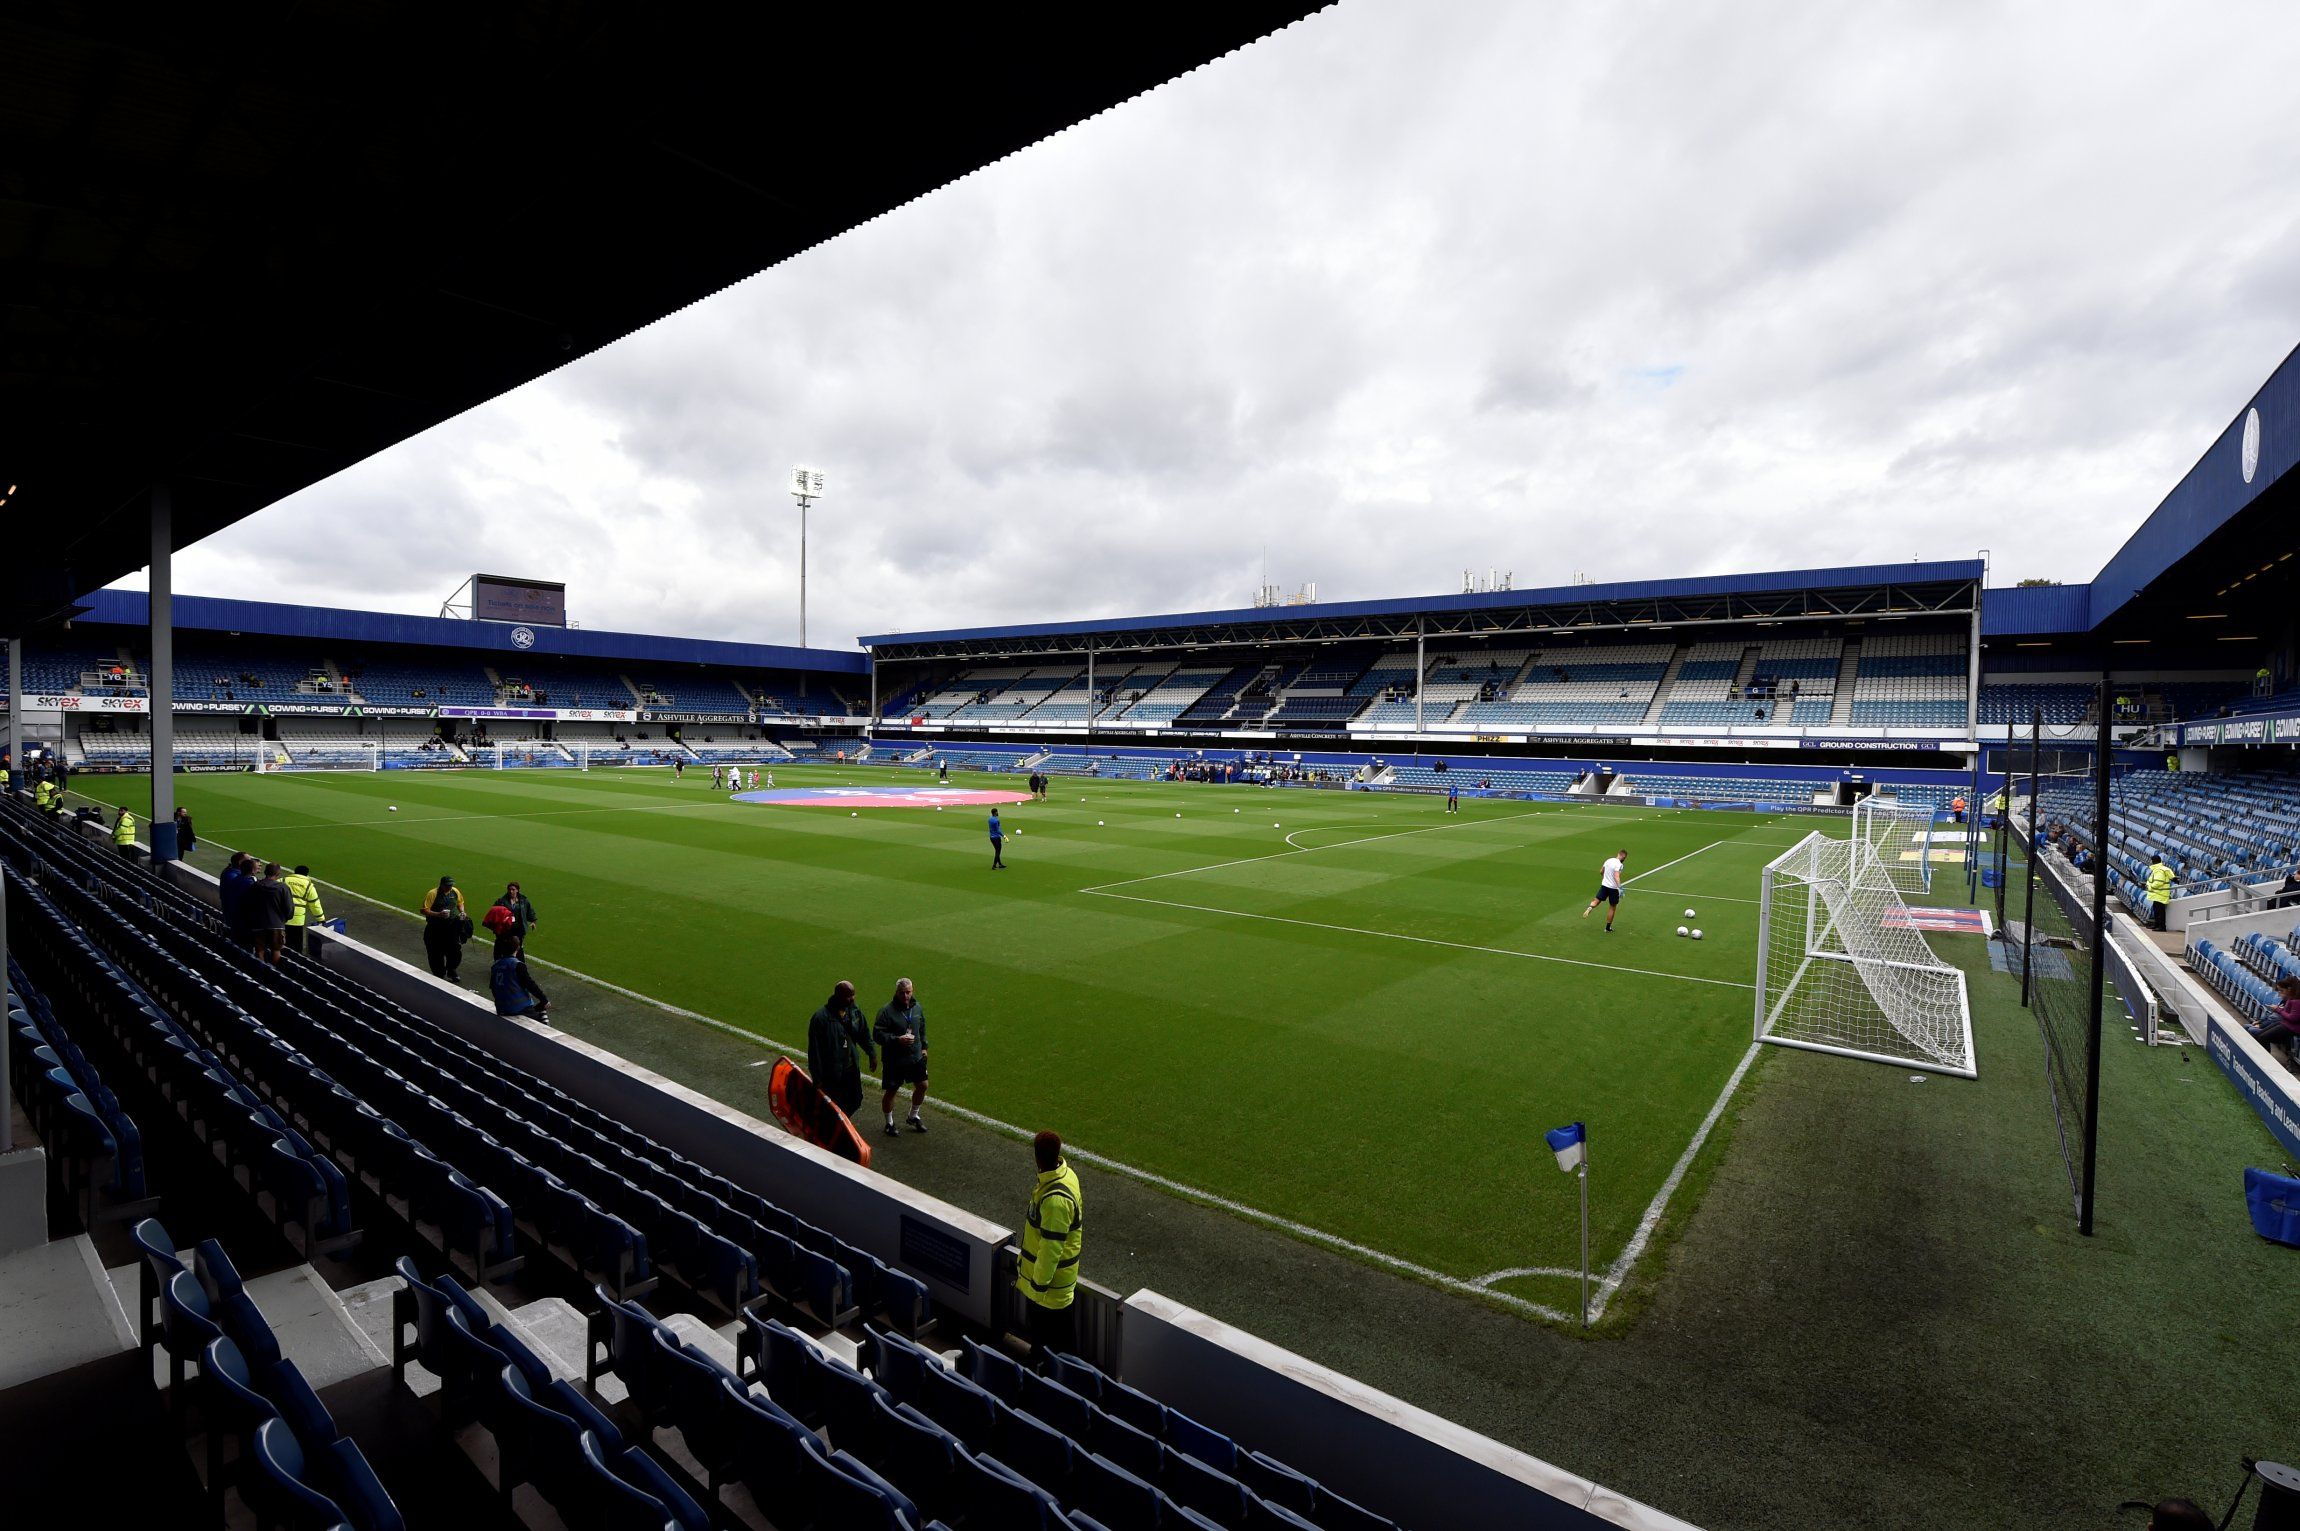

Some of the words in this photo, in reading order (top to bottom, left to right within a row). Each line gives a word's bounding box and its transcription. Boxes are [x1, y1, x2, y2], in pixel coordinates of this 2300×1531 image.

[172, 702, 203, 711] WING
[209, 703, 246, 711] PURSEY
[268, 704, 305, 712] GOWING
[311, 705, 345, 713] PURSEY
[2121, 704, 2140, 713] HU
[657, 712, 695, 721] ASHVILLE
[696, 714, 744, 722] AGGREGATES
[2245, 720, 2264, 738] PURSEY
[1820, 741, 1853, 749] GROUND
[1854, 742, 1918, 750] CONSTRUCTION
[2274, 1103, 2284, 1122] and
